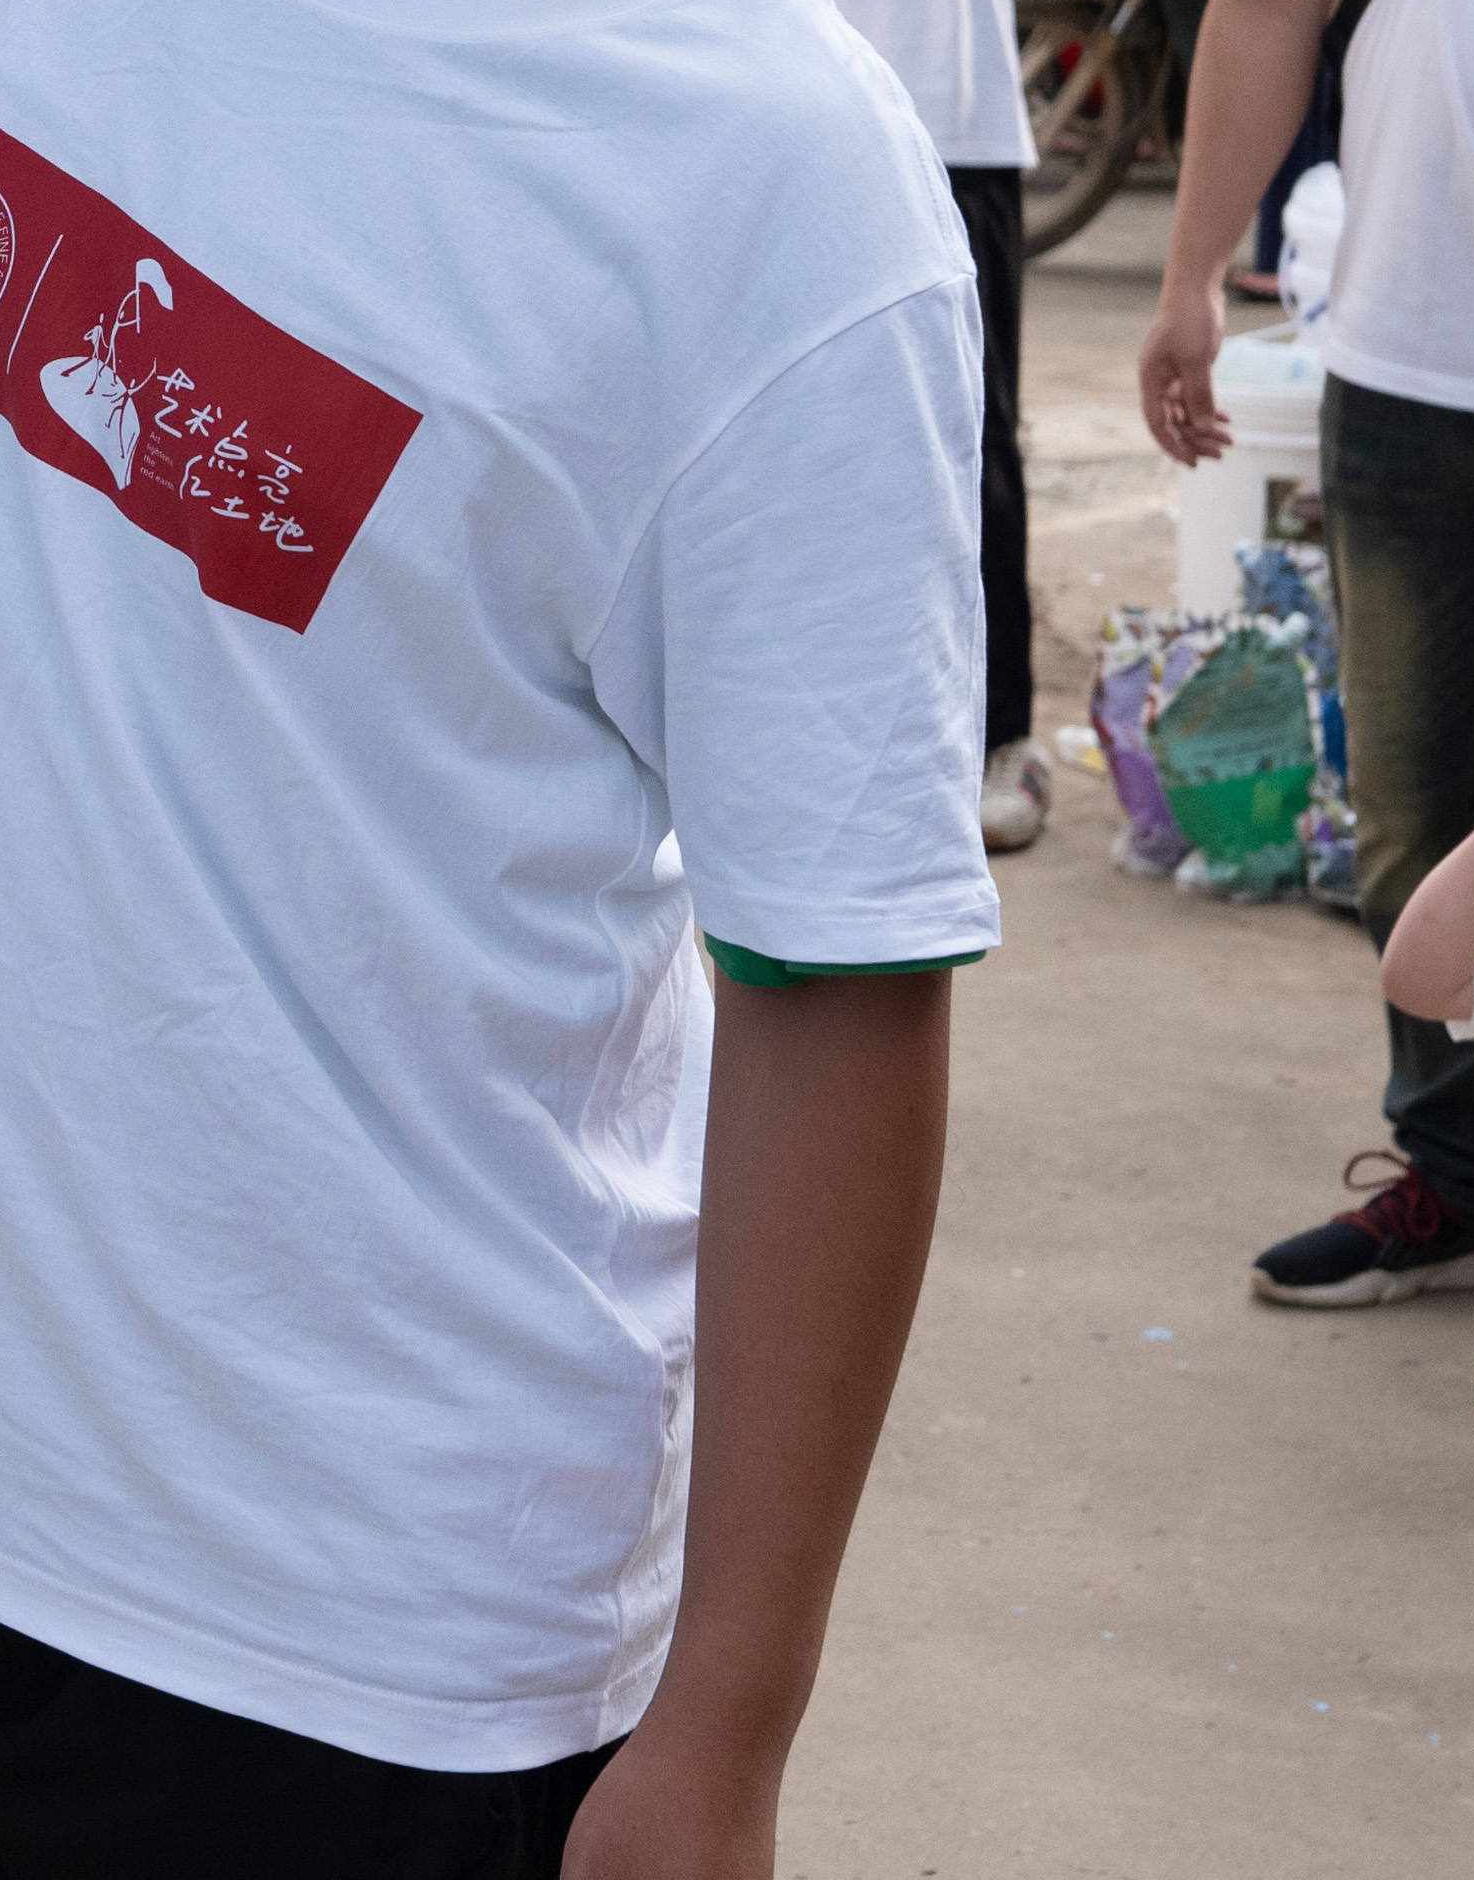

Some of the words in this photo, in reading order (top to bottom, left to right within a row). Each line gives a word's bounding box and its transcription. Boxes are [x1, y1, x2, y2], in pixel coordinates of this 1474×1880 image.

[140, 466, 154, 479] red
[156, 367, 304, 505] 艺术点亮
